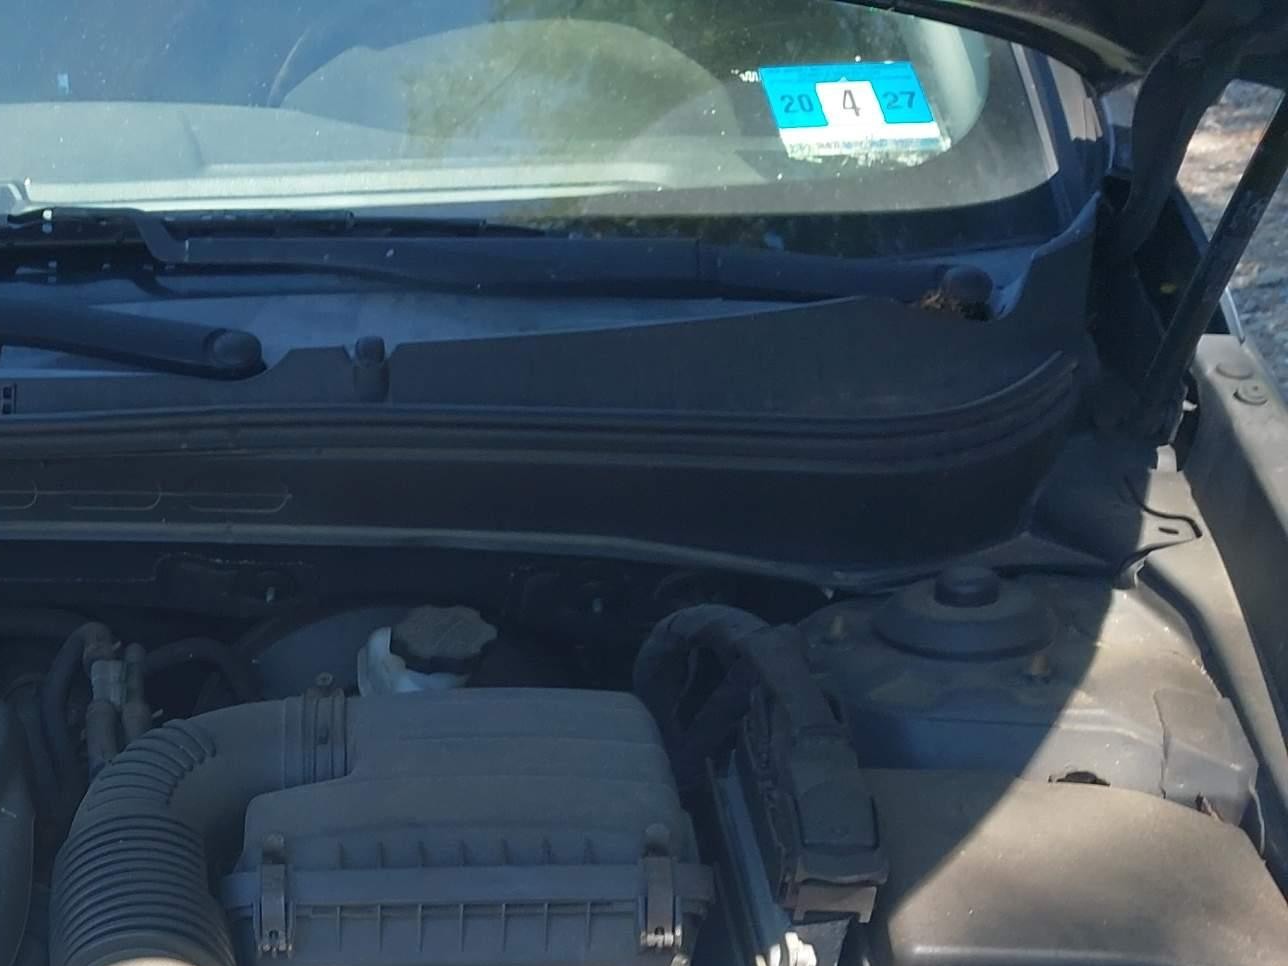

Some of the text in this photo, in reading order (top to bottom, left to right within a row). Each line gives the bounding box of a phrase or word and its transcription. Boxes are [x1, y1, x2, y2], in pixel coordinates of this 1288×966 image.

[780, 90, 916, 117] 20 4 27
